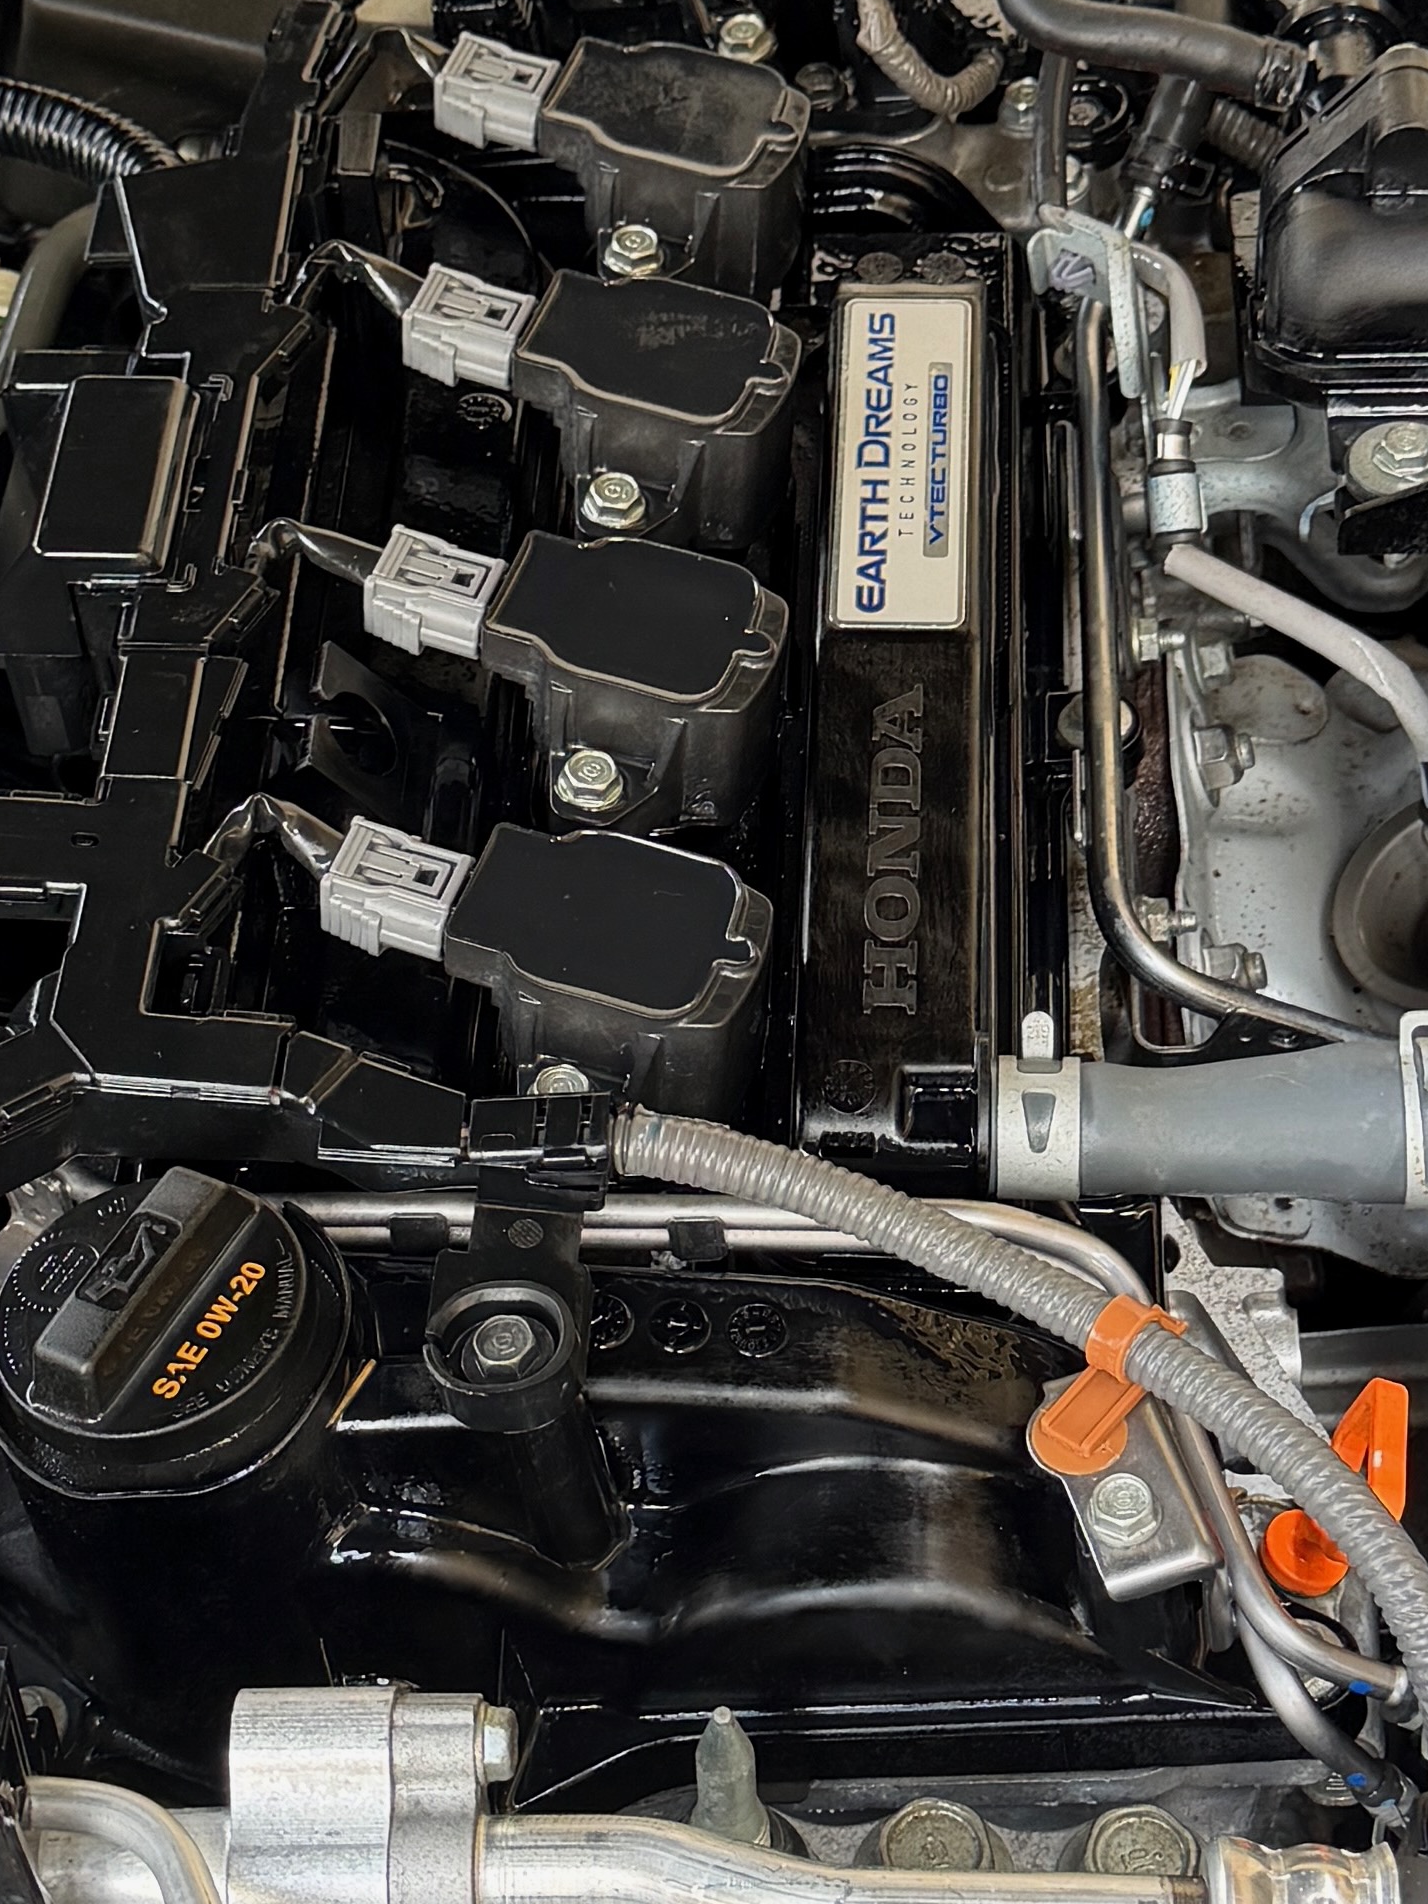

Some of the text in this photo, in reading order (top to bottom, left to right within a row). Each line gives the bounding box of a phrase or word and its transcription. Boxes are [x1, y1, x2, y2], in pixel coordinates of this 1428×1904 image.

[854, 313, 896, 614] EARTH DREAMS
[898, 382, 918, 537] TECHNOLOGY
[862, 683, 926, 1017] HONDA
[151, 1261, 266, 1401] SAE 0W-20
[271, 1251, 296, 1320] MANUAL
